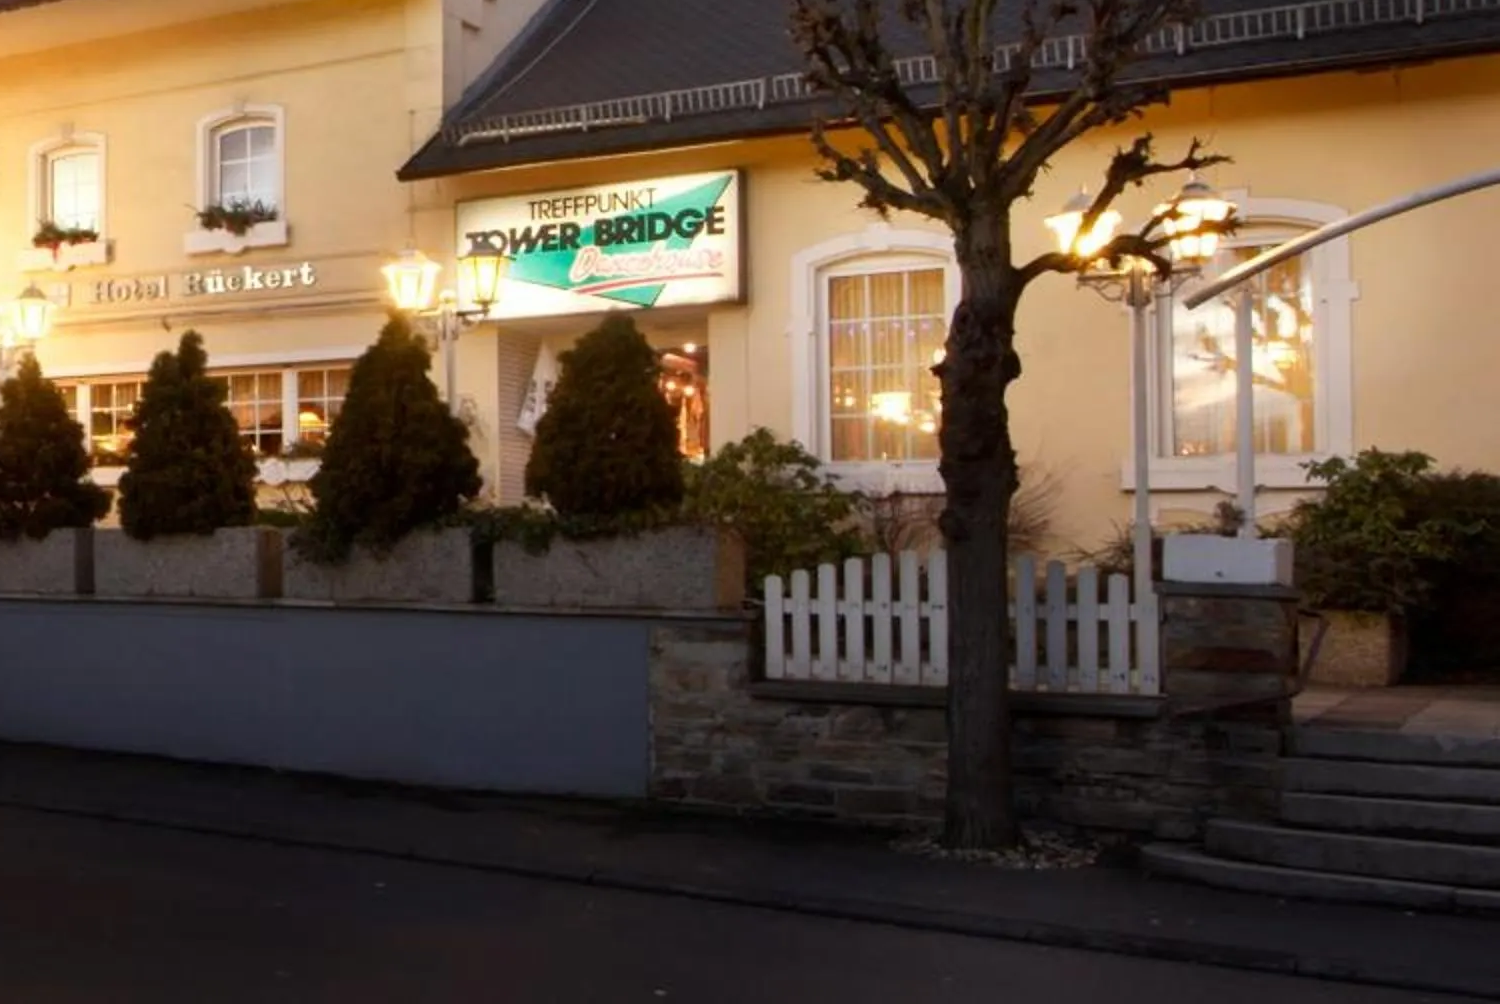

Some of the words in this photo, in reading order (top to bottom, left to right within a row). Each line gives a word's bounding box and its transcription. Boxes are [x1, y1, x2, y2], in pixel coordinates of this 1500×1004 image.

[527, 187, 657, 220] TREFFPUNKT
[594, 205, 725, 247] BRIDGE
[89, 274, 170, 306] Hotel
[183, 259, 317, 297] Rückert
